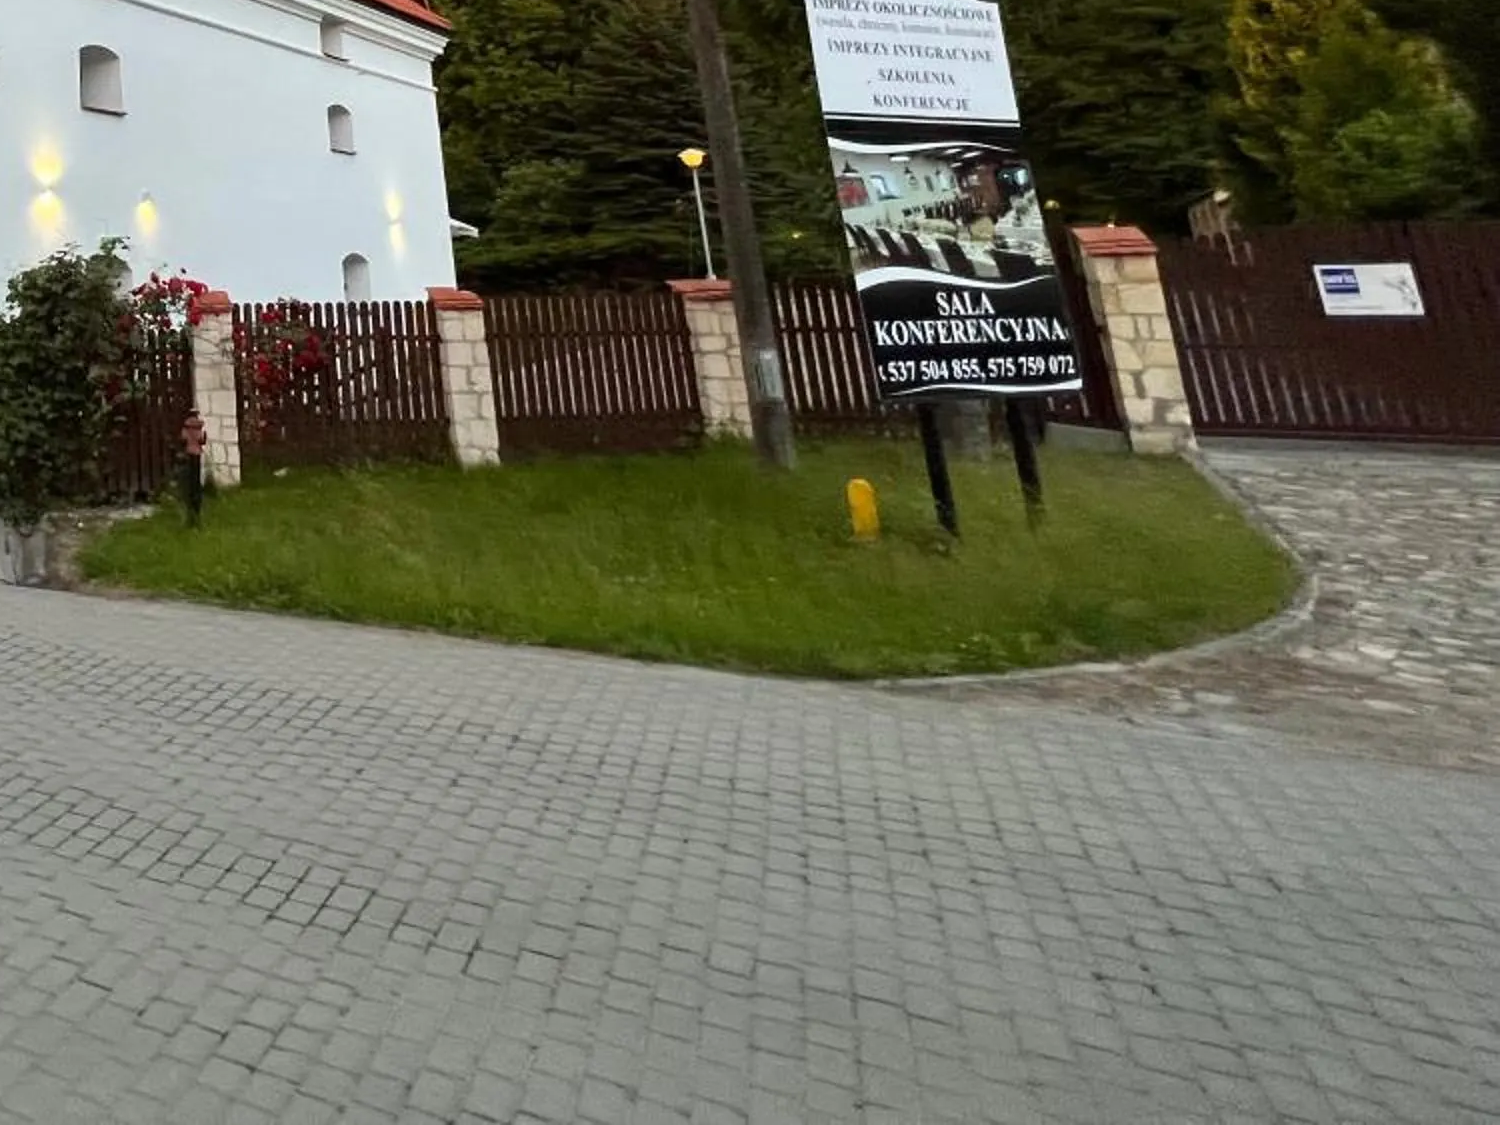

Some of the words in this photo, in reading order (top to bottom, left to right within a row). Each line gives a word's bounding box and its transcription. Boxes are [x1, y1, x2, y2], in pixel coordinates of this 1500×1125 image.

[873, 1, 994, 22] OKOLICZNOŚCIOWE
[827, 38, 890, 56] IMPREZY
[892, 43, 994, 63] INTEGRACYJNE
[877, 68, 956, 86] SZKOLENIA
[873, 93, 971, 111] KONFERENCJE
[935, 291, 996, 316] SALA
[874, 316, 1067, 346] KONFERENCYJNA
[887, 360, 916, 382] 537
[920, 359, 949, 381] 504
[951, 358, 986, 383] 855,
[988, 357, 1016, 378] 575
[1018, 356, 1045, 376] 759
[1049, 355, 1076, 375] 072
